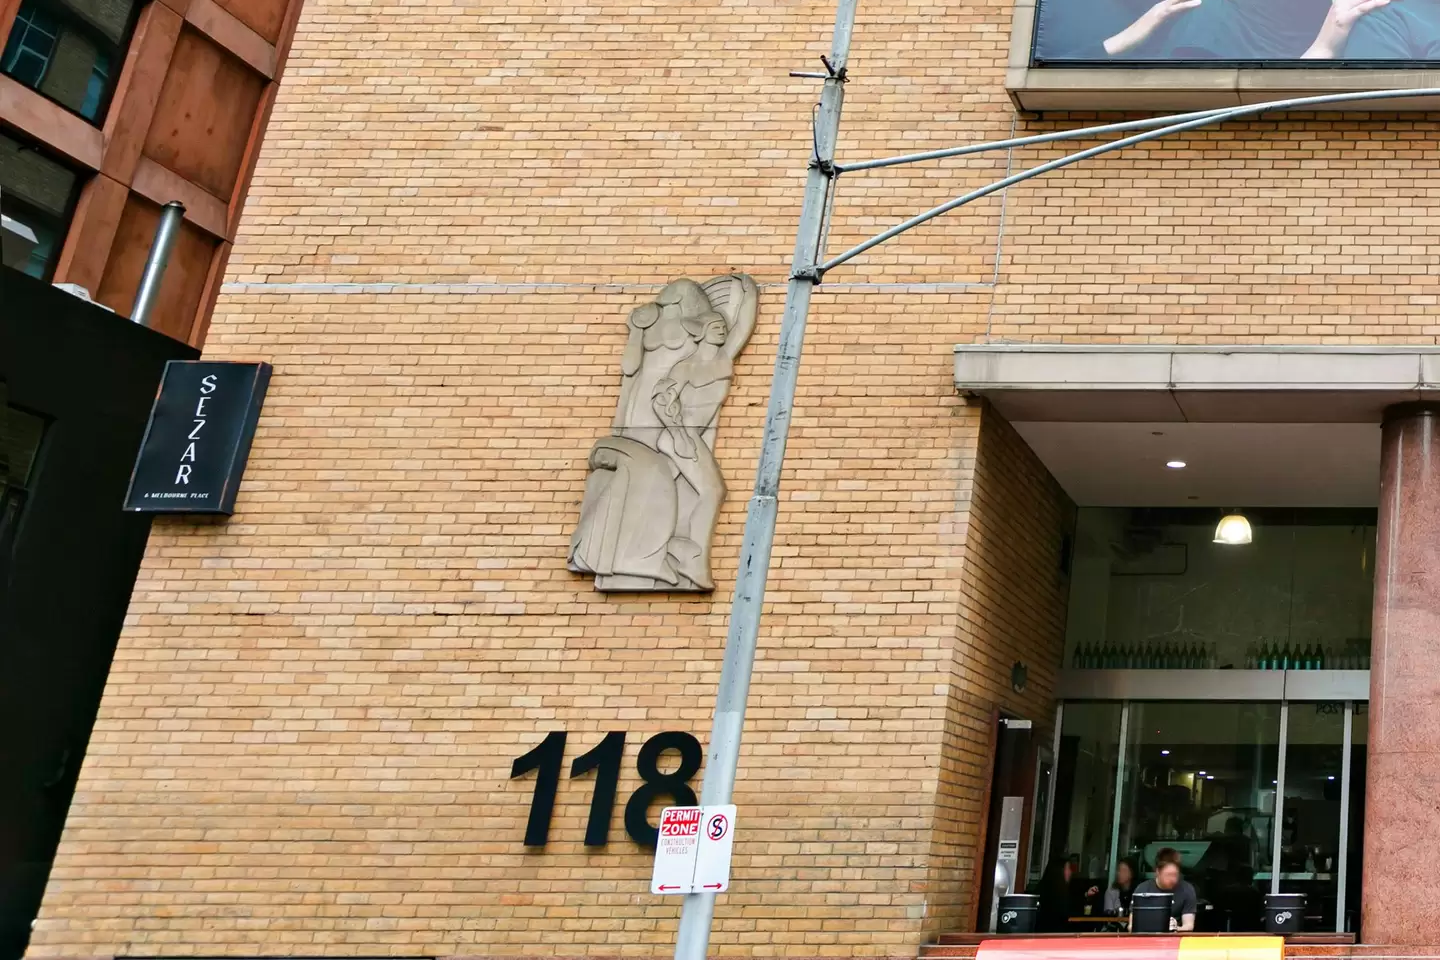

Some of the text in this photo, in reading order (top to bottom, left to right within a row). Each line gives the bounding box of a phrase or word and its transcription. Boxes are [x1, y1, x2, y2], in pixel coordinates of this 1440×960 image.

[174, 374, 218, 485] SEZAR
[510, 731, 703, 848] 118
[664, 810, 700, 821] PERMIT
[662, 823, 698, 835] ZONE
[661, 838, 696, 846] CONSTRUCTION
[666, 846, 688, 855] VEHICLES
